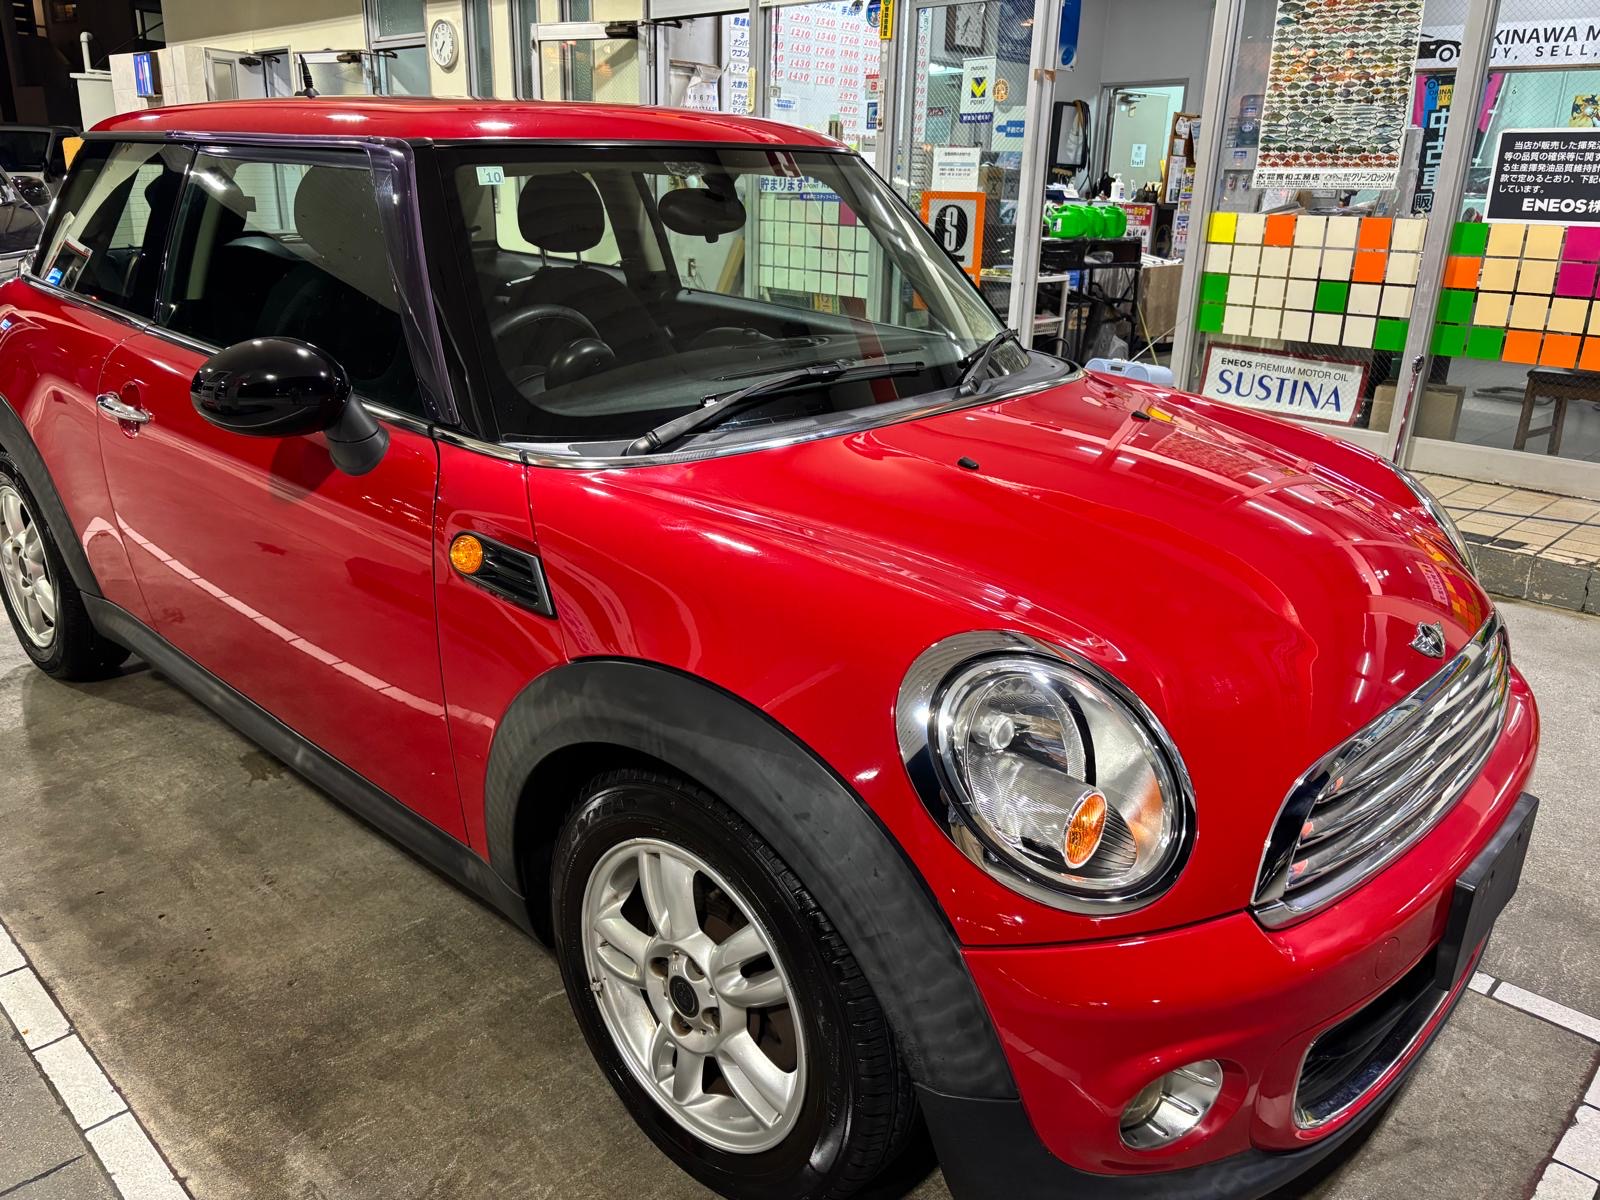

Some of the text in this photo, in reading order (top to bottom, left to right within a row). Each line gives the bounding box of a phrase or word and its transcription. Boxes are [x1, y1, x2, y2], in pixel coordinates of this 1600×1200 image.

[789, 13, 810, 23] 1210
[815, 17, 836, 27] 1540
[840, 22, 860, 31] 1760
[790, 28, 811, 39] 1210
[816, 32, 837, 41] 1540
[840, 36, 859, 46] 1760
[1494, 26, 1578, 45] KINAWA
[790, 43, 811, 53] 1430
[815, 47, 835, 57] 1760
[840, 49, 859, 59] 1980
[1535, 44, 1598, 57] SELL,
[789, 59, 811, 69] 1430
[815, 61, 835, 71] 1760
[839, 64, 858, 73] 1980
[788, 72, 809, 82] 1430
[815, 75, 835, 85] 1760
[839, 78, 858, 88] 1980
[486, 171, 502, 183] 10
[1500, 174, 1600, 184] 款で定めるとおり、下記
[1499, 185, 1545, 194] しています。
[1221, 357, 1349, 382] ENEOS PREMIUM MOTOR OIL
[1216, 369, 1342, 412] SUSTINA
